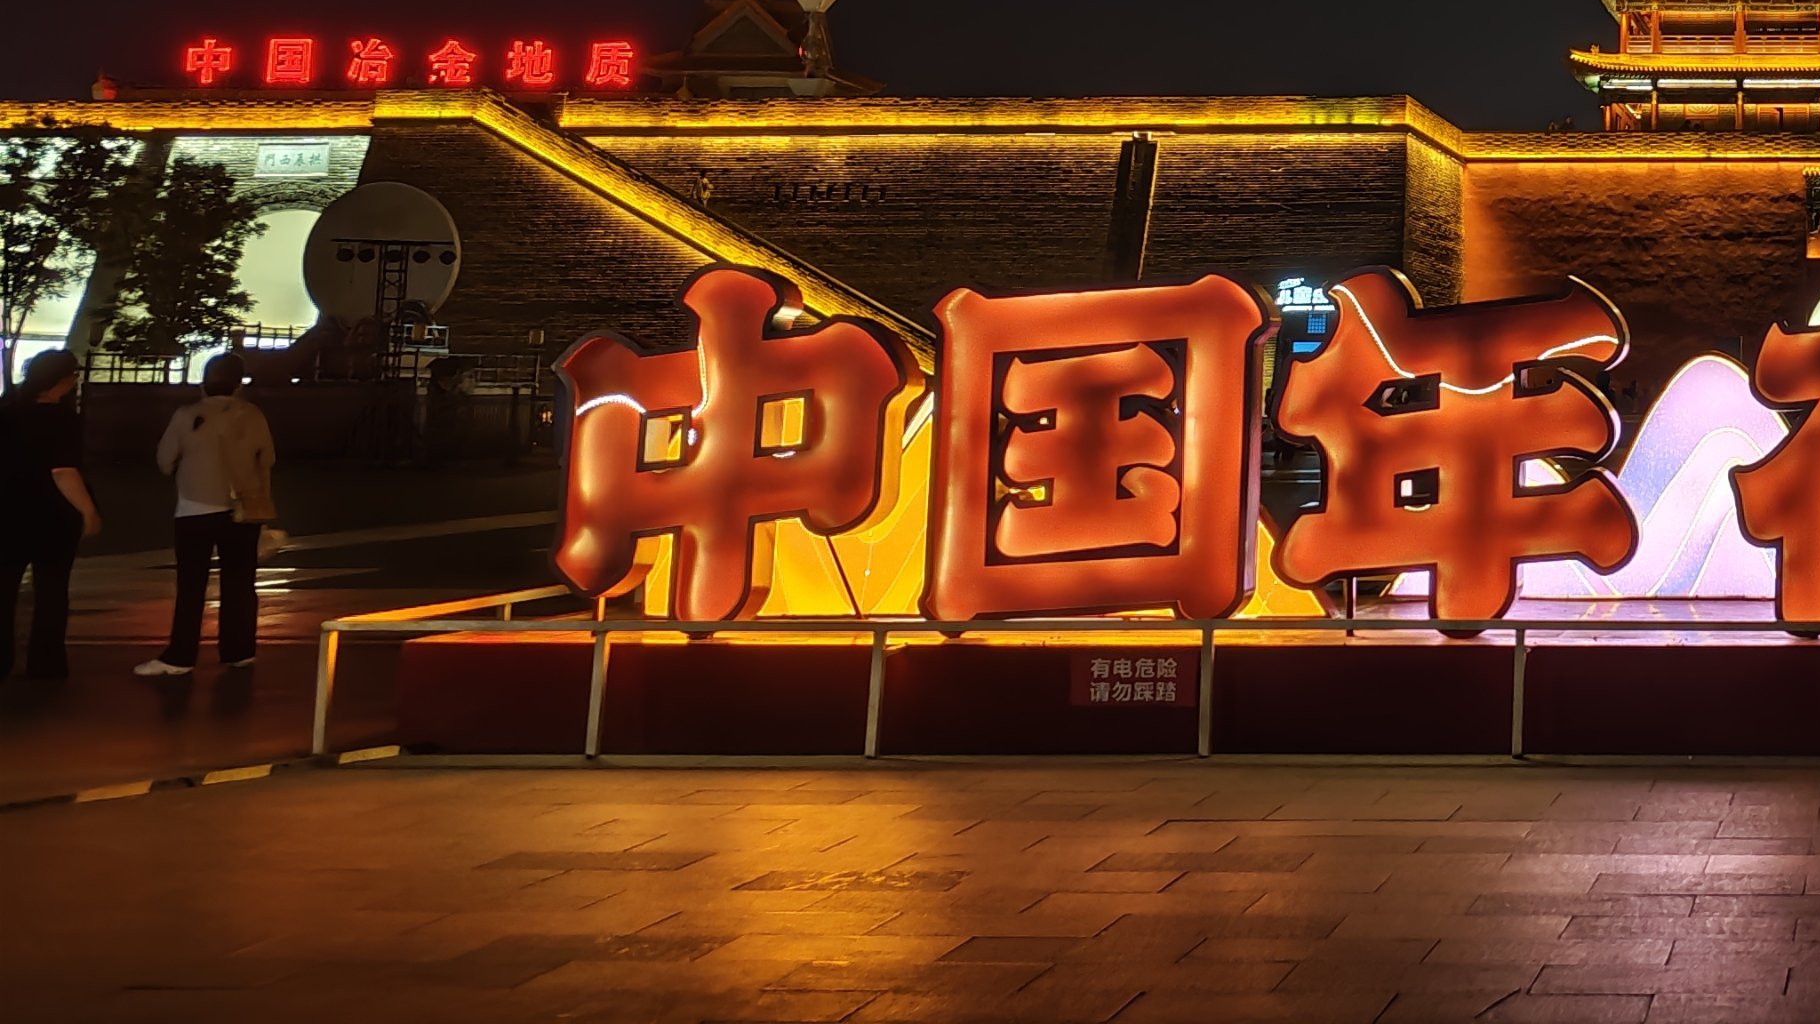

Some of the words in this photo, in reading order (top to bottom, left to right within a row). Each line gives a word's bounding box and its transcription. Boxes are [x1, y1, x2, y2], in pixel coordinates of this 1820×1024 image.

[186, 39, 635, 84] 中国冶金地质
[1090, 657, 1178, 679] 有电危险
[1090, 681, 1177, 702] 请勿踩踏
